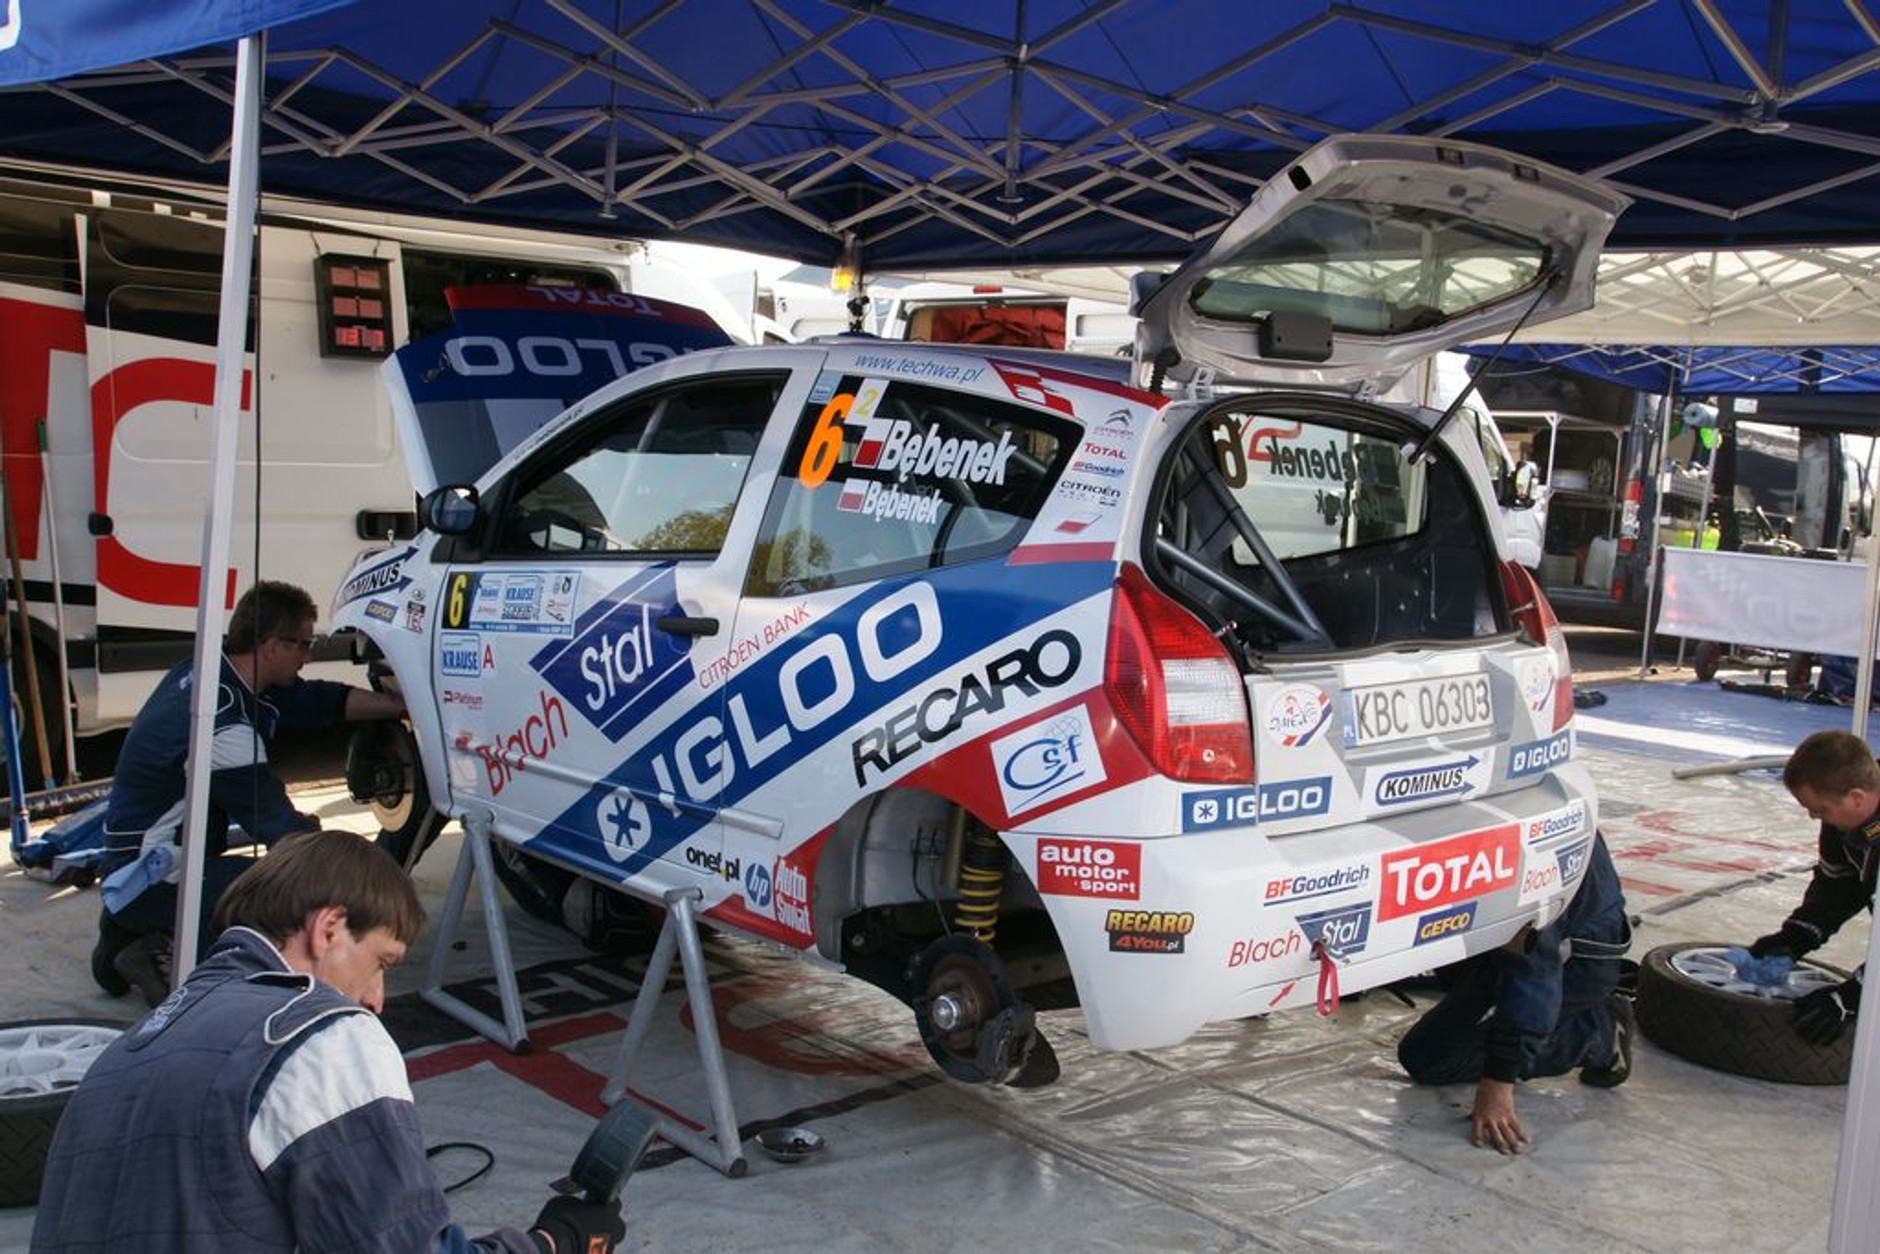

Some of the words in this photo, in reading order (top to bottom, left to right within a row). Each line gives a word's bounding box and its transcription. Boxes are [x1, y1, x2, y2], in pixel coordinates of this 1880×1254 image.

[527, 286, 662, 316] TOTAL
[445, 335, 697, 379] GLOO
[854, 354, 985, 383] www.techwa.pl
[856, 387, 879, 417] 2
[799, 393, 856, 490] 6
[877, 419, 1017, 486] Bębenek
[1085, 443, 1126, 460] TOTAL
[862, 482, 944, 524] Bębenek
[449, 574, 467, 627] 6
[763, 600, 812, 645] BANK
[442, 650, 478, 671] KRAUSE
[483, 644, 494, 669] A
[580, 602, 654, 711] Stal
[652, 581, 942, 818] IGLOO
[852, 629, 1082, 789] RECARO
[1355, 691, 1408, 739] KBC
[1419, 679, 1491, 729] 06303
[475, 690, 569, 797] Blach
[1527, 738, 1568, 768] IGLOO
[1385, 769, 1463, 798] KOMINUS
[1226, 786, 1323, 820] IGLOO
[1529, 809, 1584, 838] BFGoodrich
[686, 847, 740, 882] onet.pl
[1040, 845, 1115, 865] auto
[749, 864, 769, 906] hp
[1055, 865, 1130, 880] motor
[1081, 880, 1136, 895] sport
[1265, 864, 1369, 899] BFGoodrich
[1388, 846, 1514, 906] TOTAL
[1107, 911, 1193, 933] RECARO
[1321, 914, 1362, 946] Stal
[1421, 912, 1470, 938] GEFCO
[1228, 929, 1301, 967] Blach
